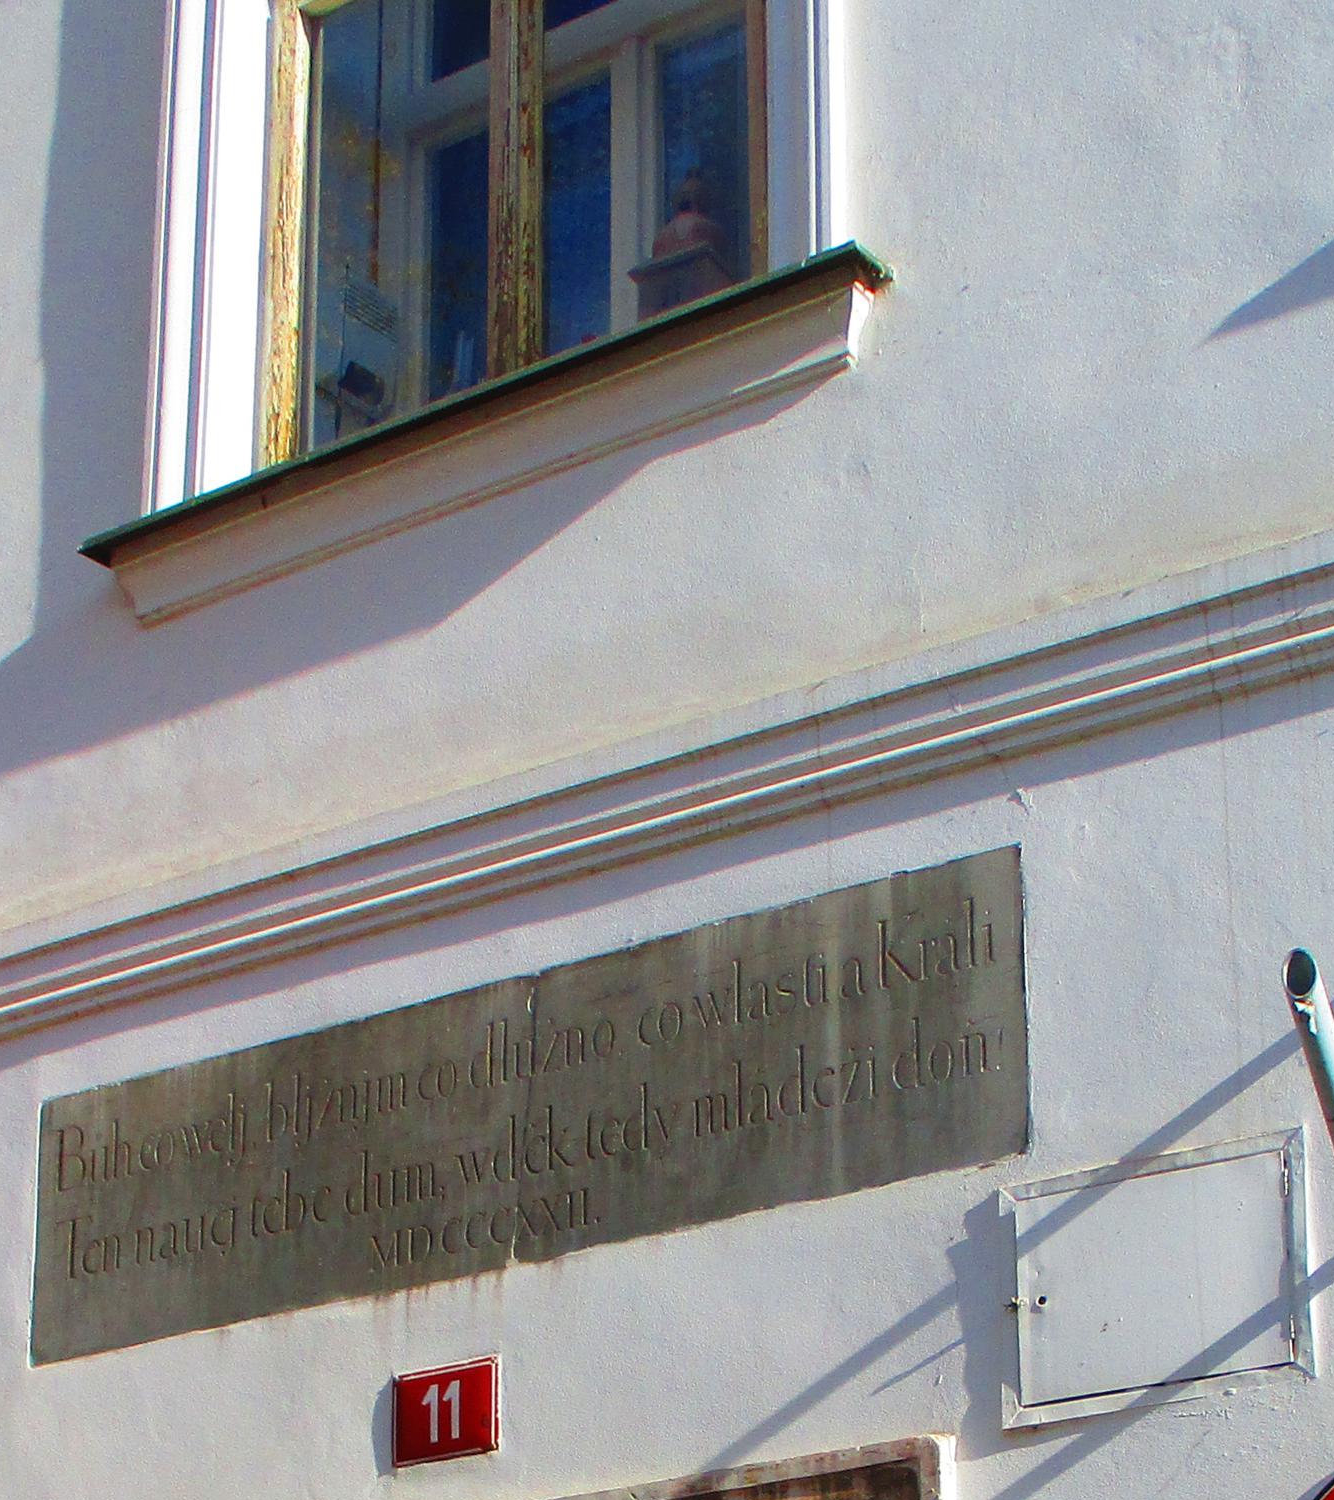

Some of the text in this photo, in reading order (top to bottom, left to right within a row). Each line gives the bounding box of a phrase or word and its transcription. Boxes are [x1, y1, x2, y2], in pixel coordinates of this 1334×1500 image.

[417, 1059, 458, 1101] co
[636, 1000, 683, 1048] co
[837, 956, 866, 1000] a
[55, 1214, 121, 1281] Ten
[421, 1379, 461, 1444] 11
